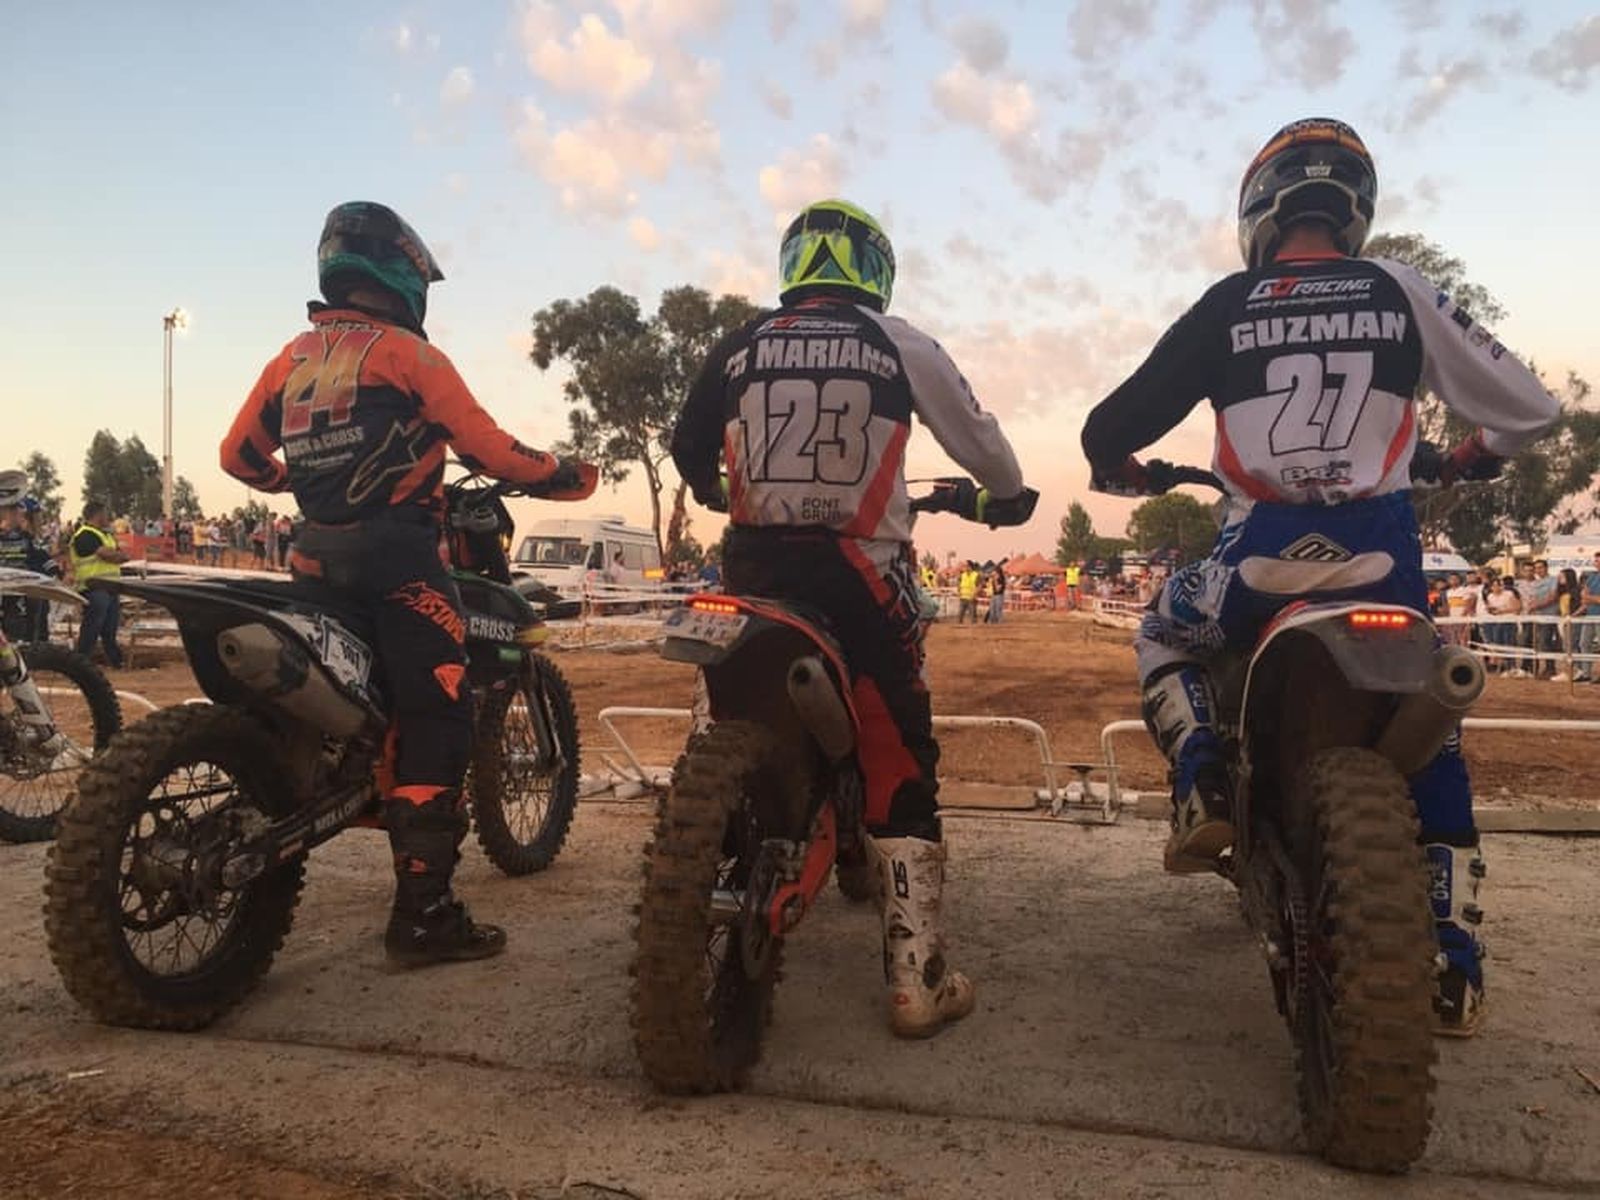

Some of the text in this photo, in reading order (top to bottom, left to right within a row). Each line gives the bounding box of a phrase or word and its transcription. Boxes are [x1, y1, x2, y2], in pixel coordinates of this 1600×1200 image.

[280, 328, 383, 438] 24
[1230, 311, 1406, 354] GUZMAN
[738, 378, 873, 486] 123
[1266, 351, 1374, 456] 27
[469, 616, 516, 642] CROSS
